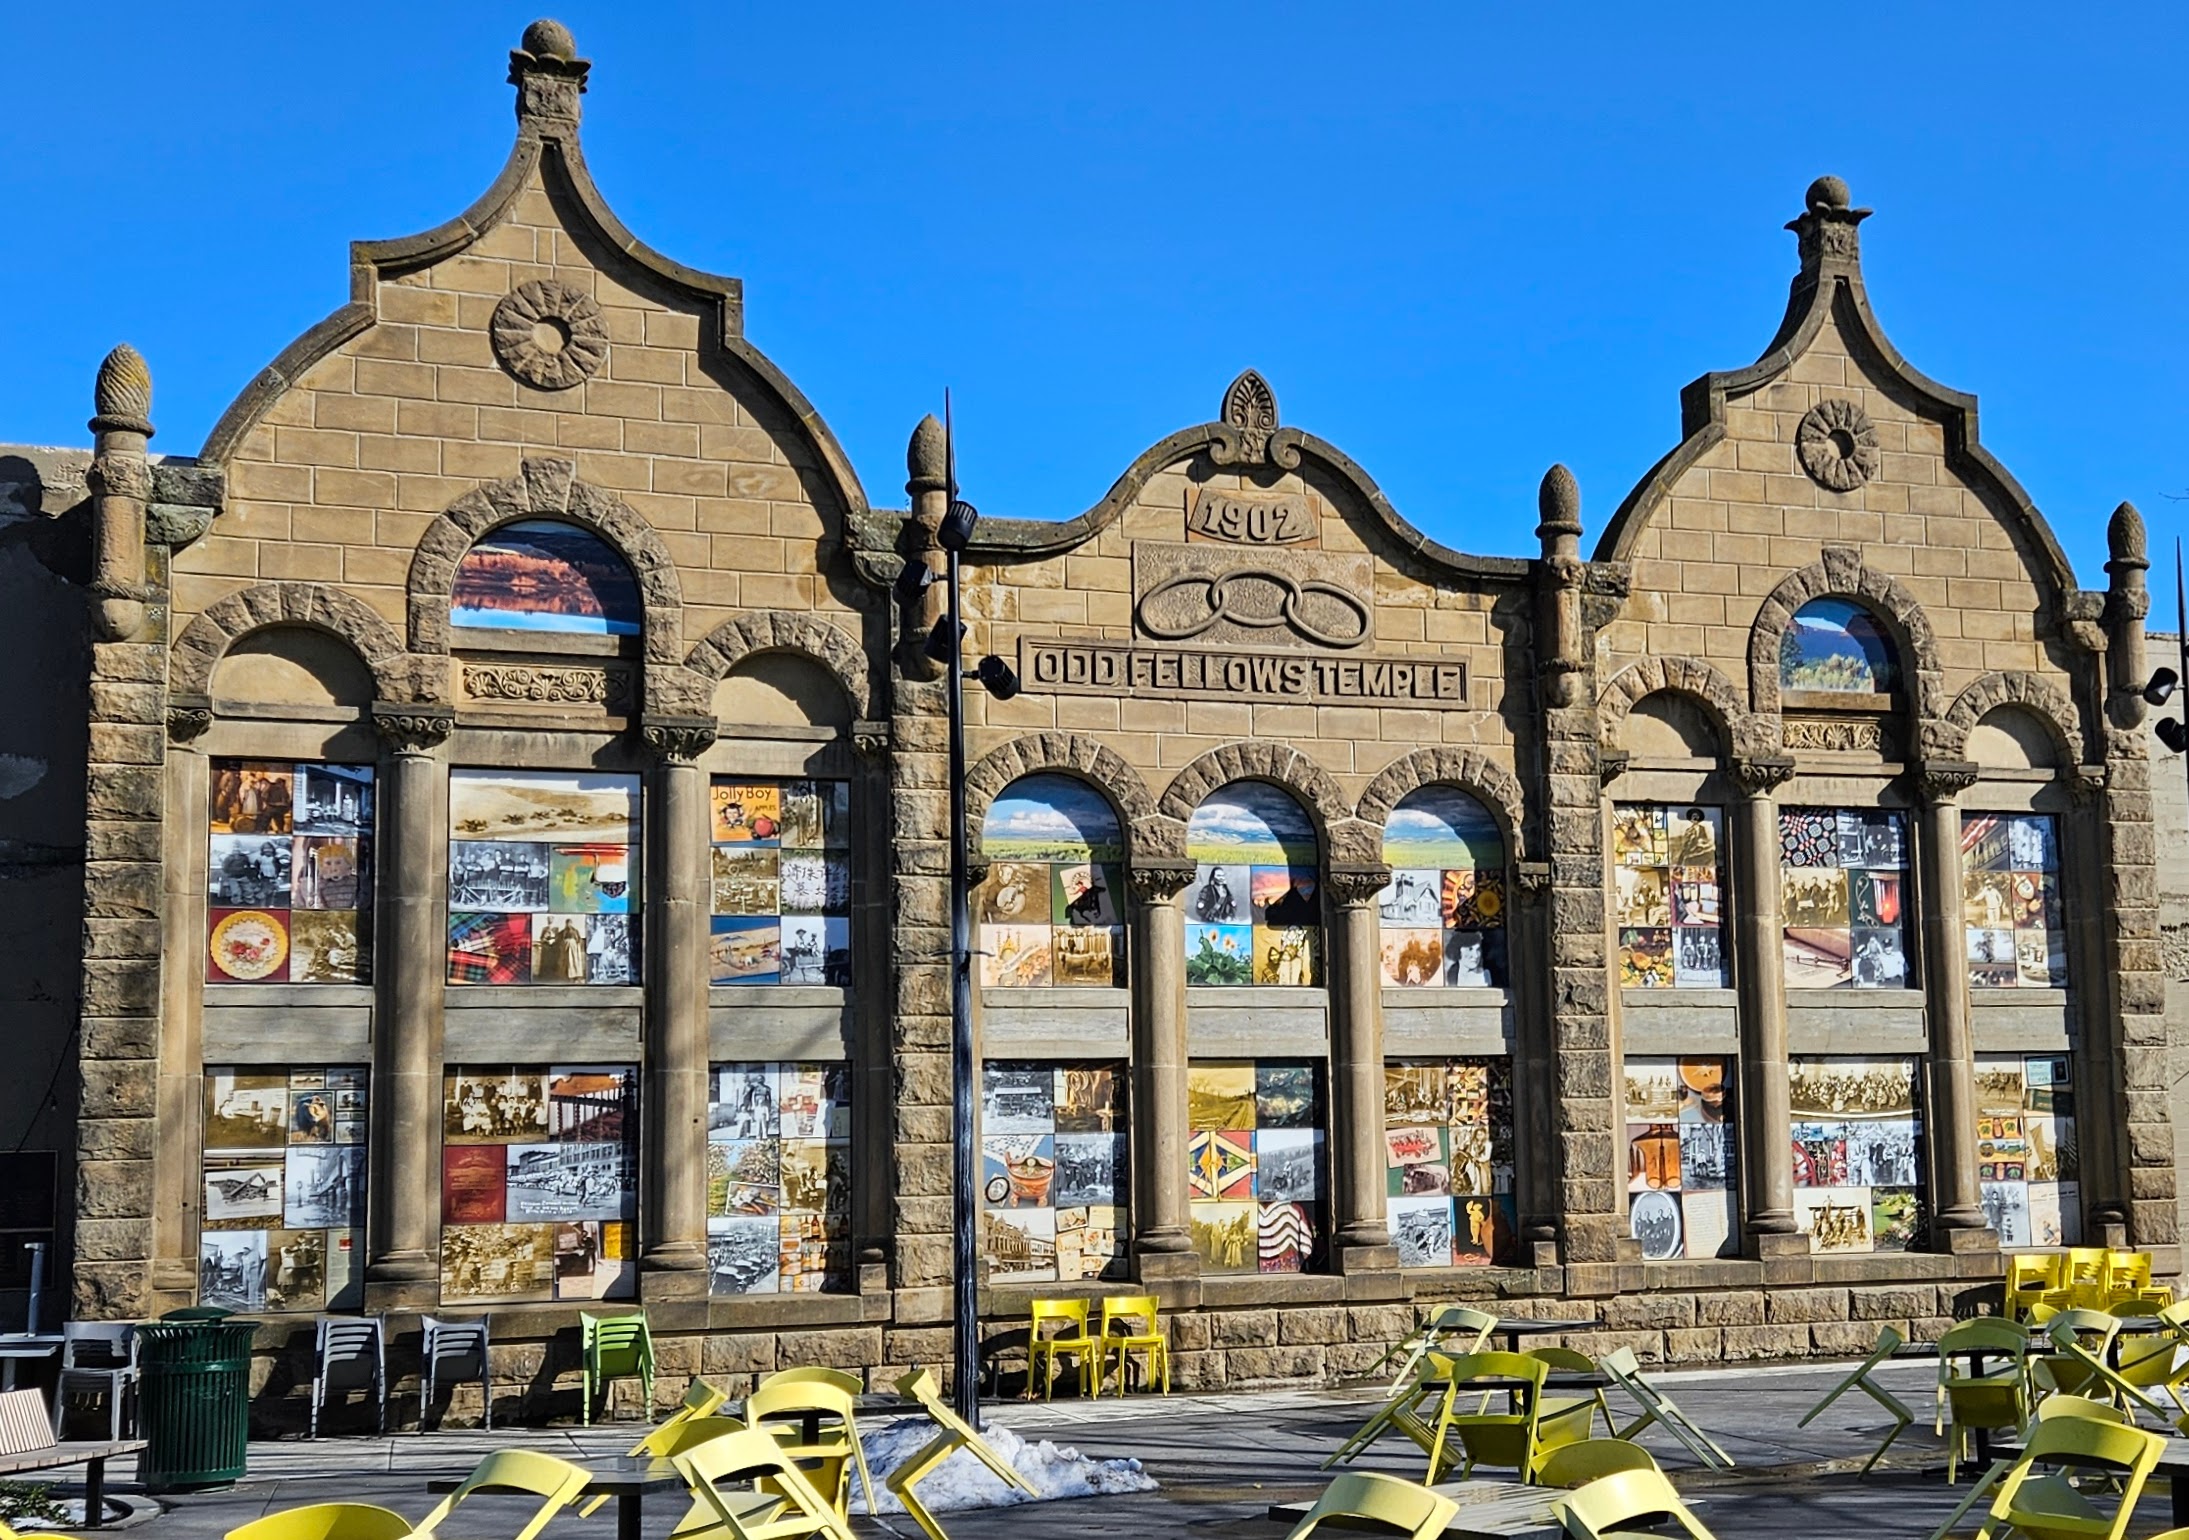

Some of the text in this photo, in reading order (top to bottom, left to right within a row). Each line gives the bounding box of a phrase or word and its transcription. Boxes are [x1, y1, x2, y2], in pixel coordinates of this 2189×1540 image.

[1202, 500, 1303, 541] 1902
[1036, 648, 1461, 700] ODD FELLOWS TEMPLE
[712, 786, 772, 802] Jolly Boy
